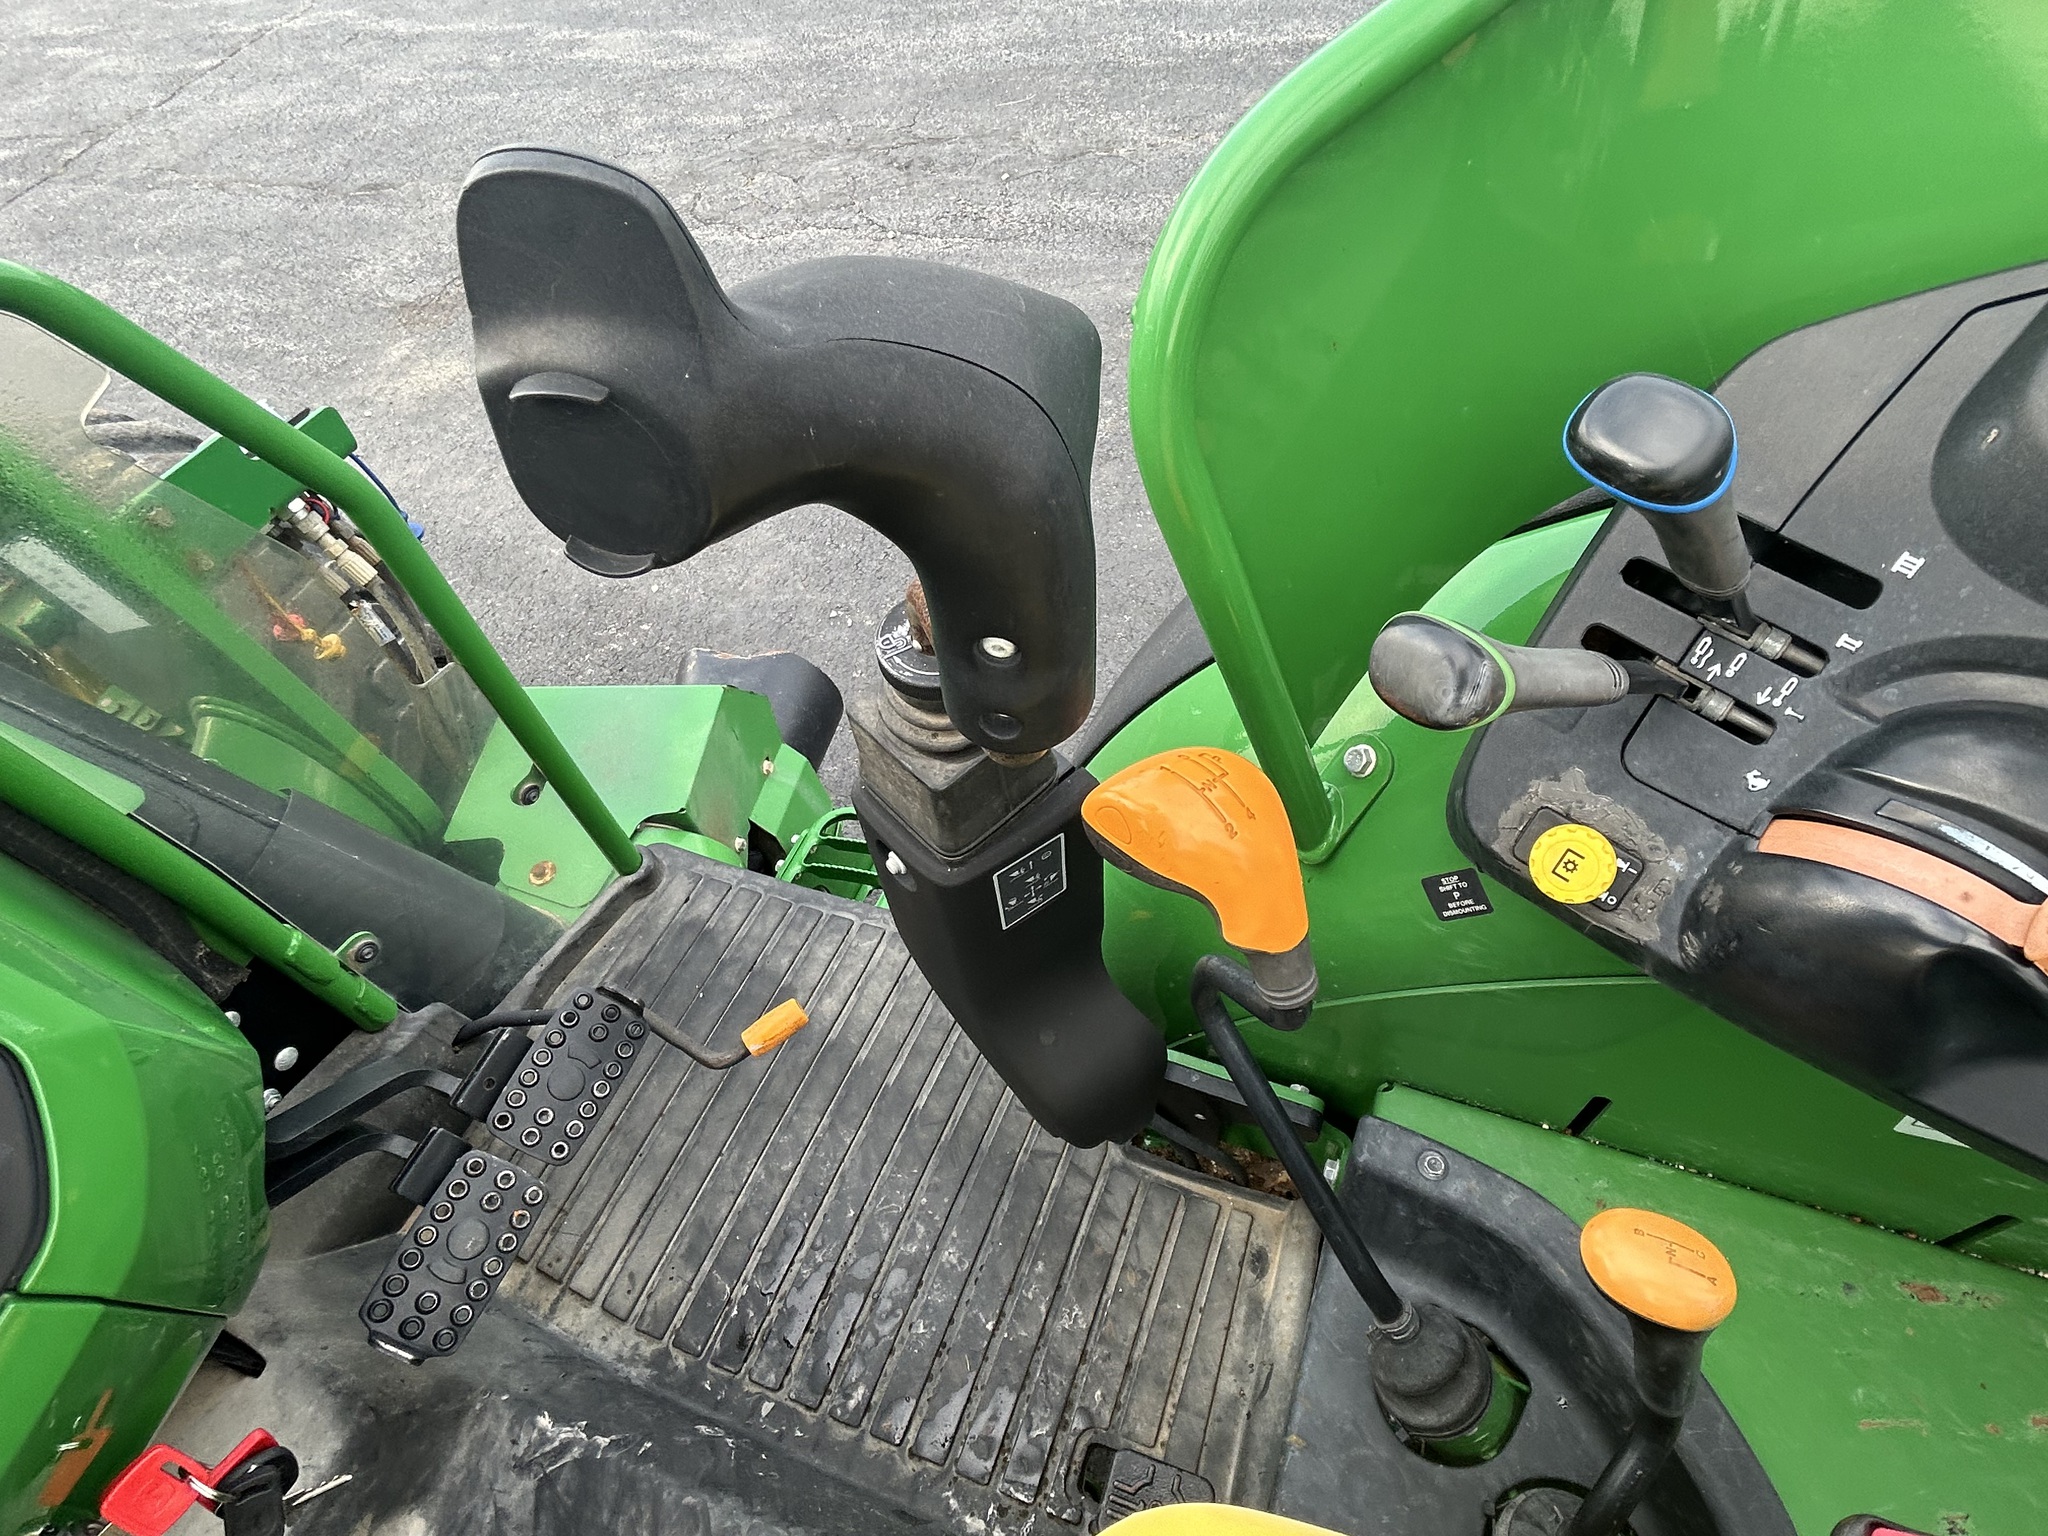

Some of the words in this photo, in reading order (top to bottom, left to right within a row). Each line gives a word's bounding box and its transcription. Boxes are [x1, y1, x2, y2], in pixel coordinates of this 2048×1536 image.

[1225, 822, 1238, 839] 2
[1440, 875, 1460, 885] STOP
[1439, 884, 1457, 892] SHIFT
[1458, 881, 1468, 889] TO
[1452, 891, 1461, 900] P
[1447, 899, 1475, 908] BEFORE
[1442, 904, 1487, 917] DISMOUNTING
[1706, 1276, 1717, 1286] A
